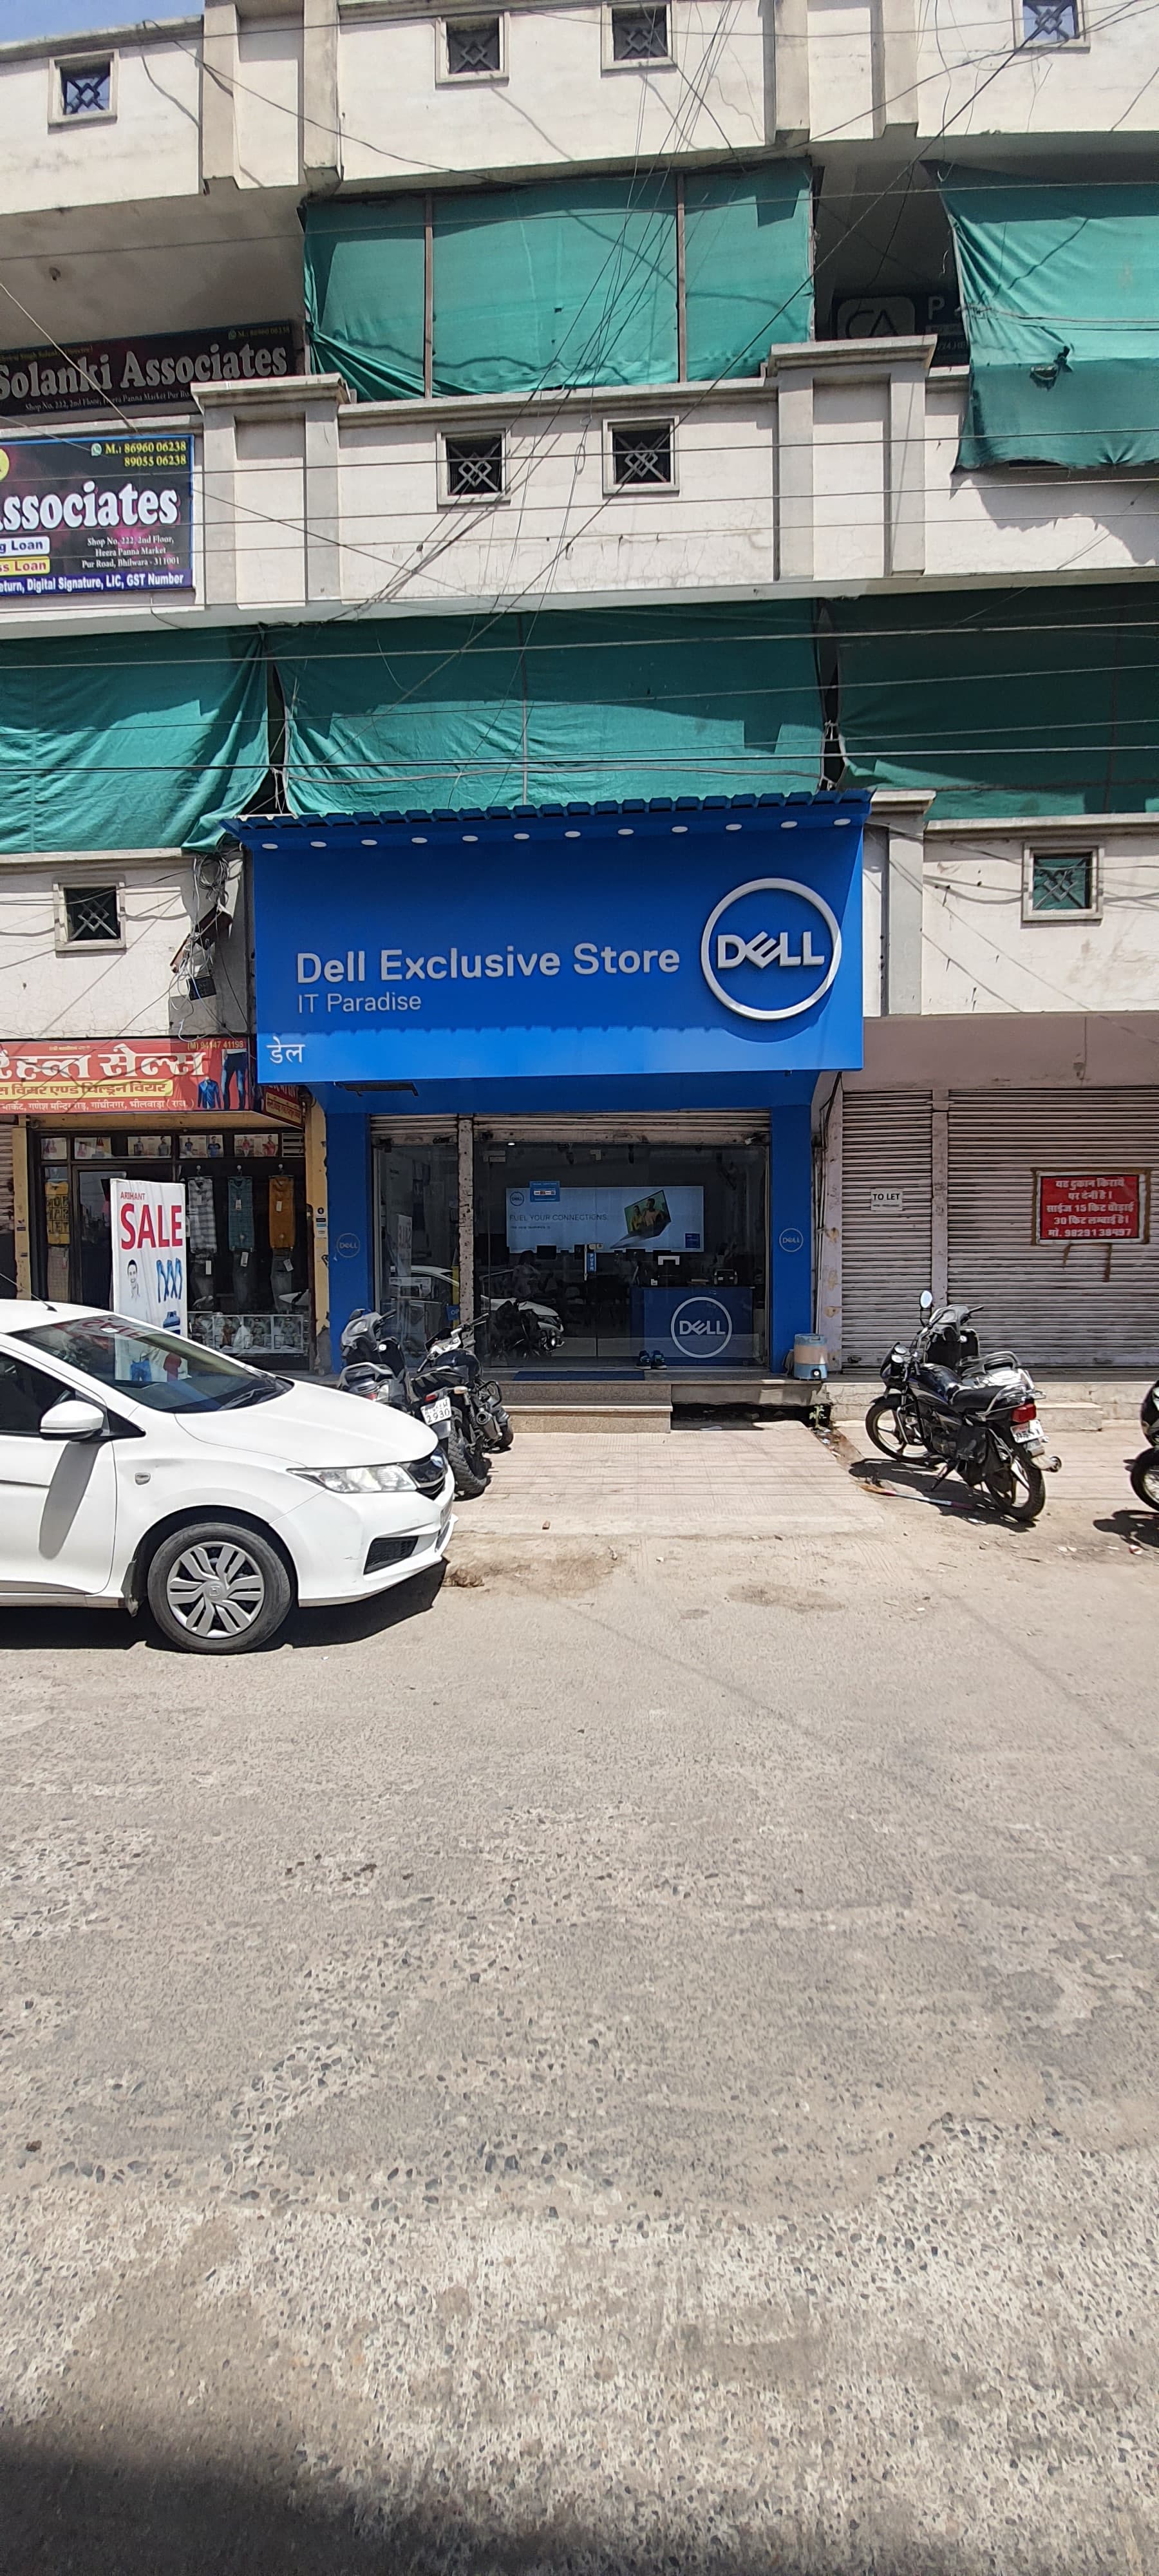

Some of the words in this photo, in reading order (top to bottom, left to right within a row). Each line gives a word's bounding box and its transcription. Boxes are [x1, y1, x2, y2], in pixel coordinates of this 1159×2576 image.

[0, 354, 112, 399] Solanki
[120, 343, 287, 388] Associates
[124, 442, 154, 453] 86960
[156, 441, 186, 452] 06238
[124, 456, 154, 467] 89055
[156, 454, 187, 466] 06238
[0, 480, 178, 531] ssociates
[12, 540, 43, 551] Loan
[87, 537, 105, 548] Shop
[138, 535, 151, 544] 2nd
[153, 535, 174, 545] Floor,
[95, 549, 117, 558] Heera
[118, 547, 139, 556] Panna
[140, 547, 166, 555] Market
[14, 560, 46, 571] Loan
[82, 560, 95, 569] Pur
[96, 559, 116, 569] Road,
[118, 558, 148, 567] Bhilwara
[154, 556, 180, 566] 311001
[26, 577, 56, 594] Digital
[58, 576, 104, 592] Signature,
[106, 574, 124, 590] LIC,
[126, 573, 147, 587] GST
[148, 572, 184, 585] Number
[717, 931, 825, 969] DELL
[297, 950, 365, 983] Dell
[381, 946, 560, 981] Exclusive
[573, 943, 681, 975] Store
[299, 993, 319, 1014] IT
[327, 992, 422, 1012] Paradise
[266, 1036, 305, 1064] डेल
[98, 1043, 206, 1078] सेल्स
[50, 1086, 79, 1095] एण्ड
[130, 1081, 167, 1093] वियर
[120, 1191, 146, 1200] ARIHANT
[120, 1202, 183, 1250] SALE
[679, 1320, 726, 1336] DELL
